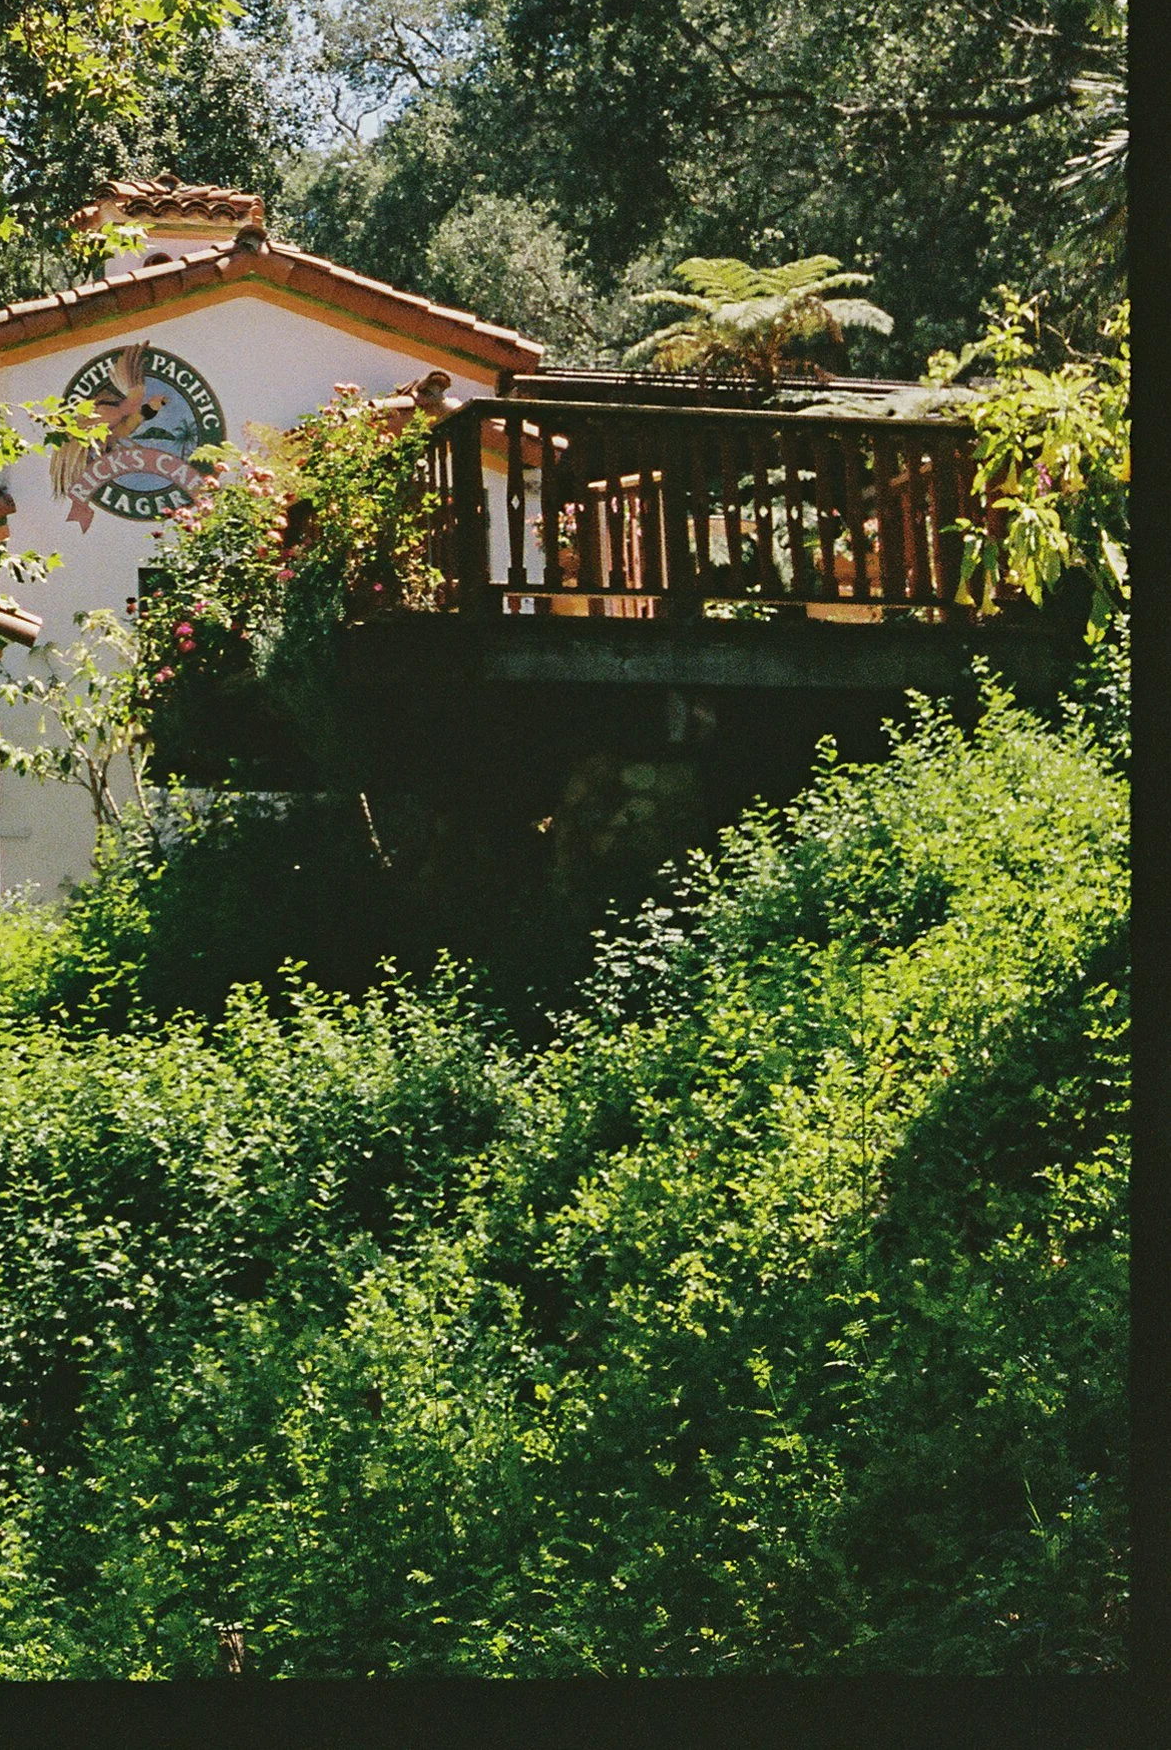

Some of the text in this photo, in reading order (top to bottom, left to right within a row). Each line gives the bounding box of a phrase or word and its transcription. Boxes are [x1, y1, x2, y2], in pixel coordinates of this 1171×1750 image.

[67, 354, 220, 430] OUTH PACIFIC
[69, 449, 204, 502] RICK'S CAF
[99, 486, 190, 516] LAGER
